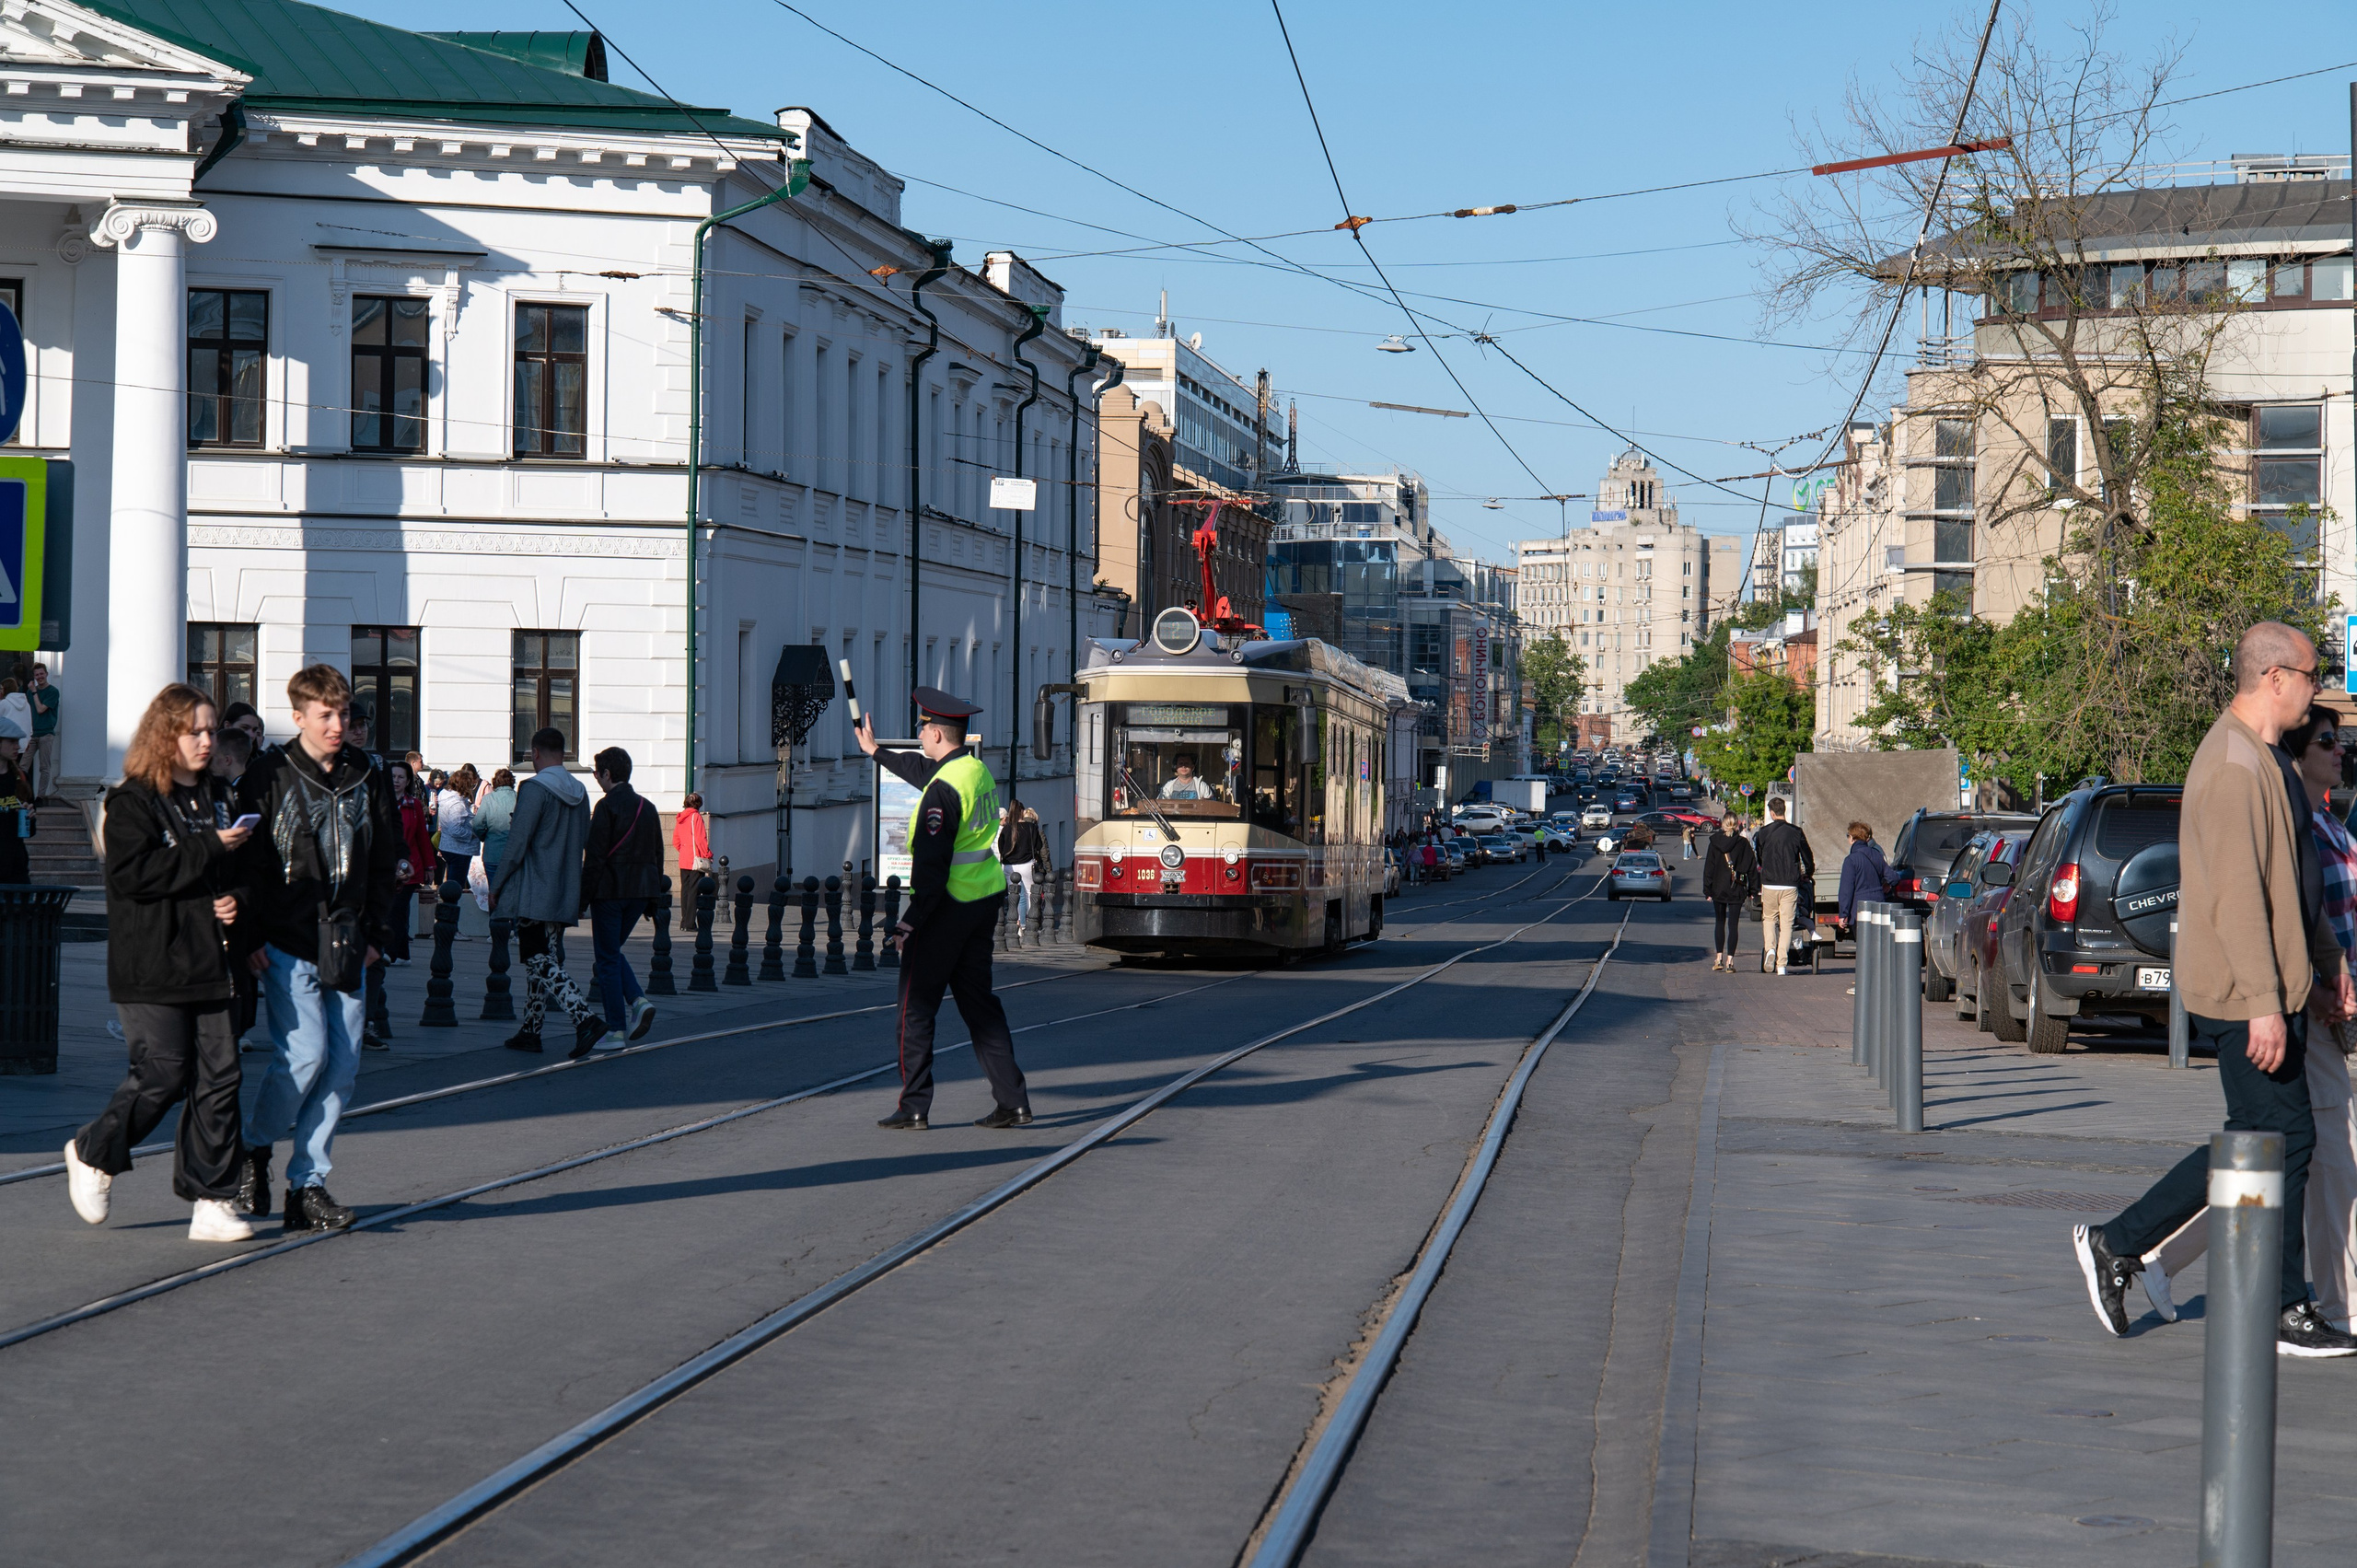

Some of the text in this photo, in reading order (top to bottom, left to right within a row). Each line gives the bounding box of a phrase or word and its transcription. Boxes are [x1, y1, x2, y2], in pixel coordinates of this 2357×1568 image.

[1475, 627, 1487, 720] БОКОНЧИНО
[1142, 706, 1215, 717] ГОРОДСКОЕ
[1154, 716, 1202, 726] КОЛЬЦО
[1137, 869, 1155, 879] 1036
